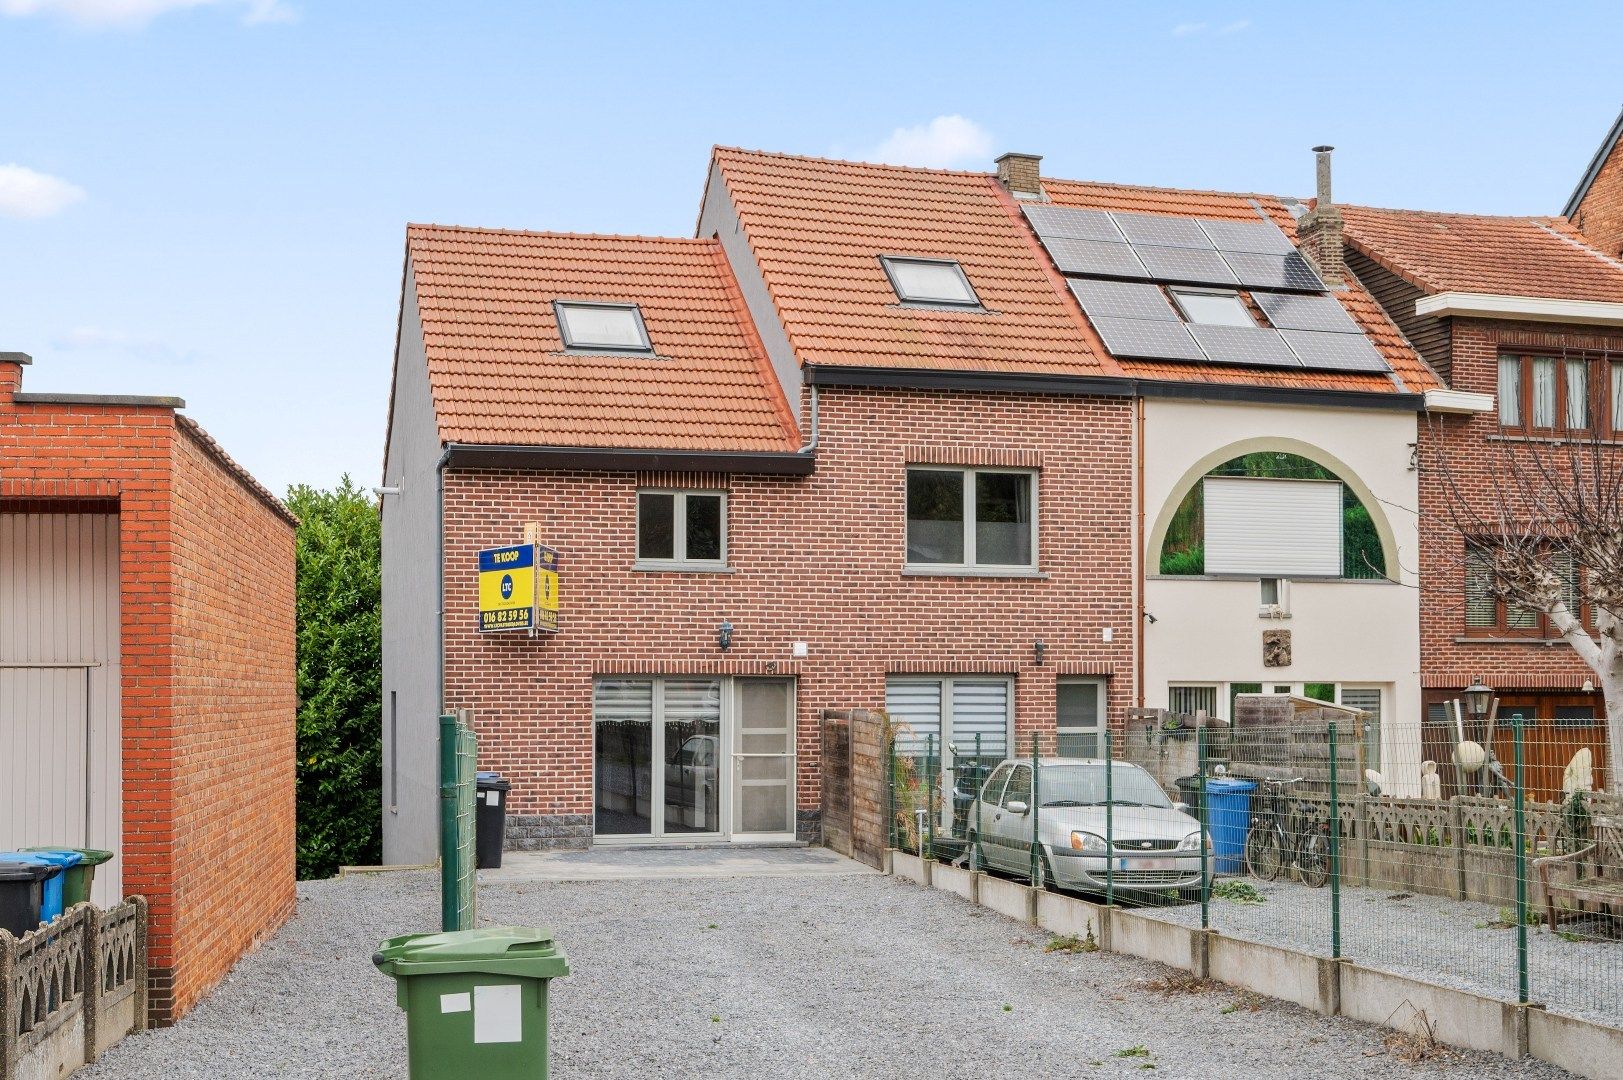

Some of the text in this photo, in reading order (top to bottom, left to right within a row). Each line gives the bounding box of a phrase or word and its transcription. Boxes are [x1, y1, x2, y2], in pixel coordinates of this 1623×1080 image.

[494, 551, 519, 563] TE KOOP
[502, 583, 511, 591] LTC
[484, 612, 496, 623] 016
[498, 611, 506, 621] 82
[509, 610, 517, 621] 59
[519, 609, 528, 620] 56
